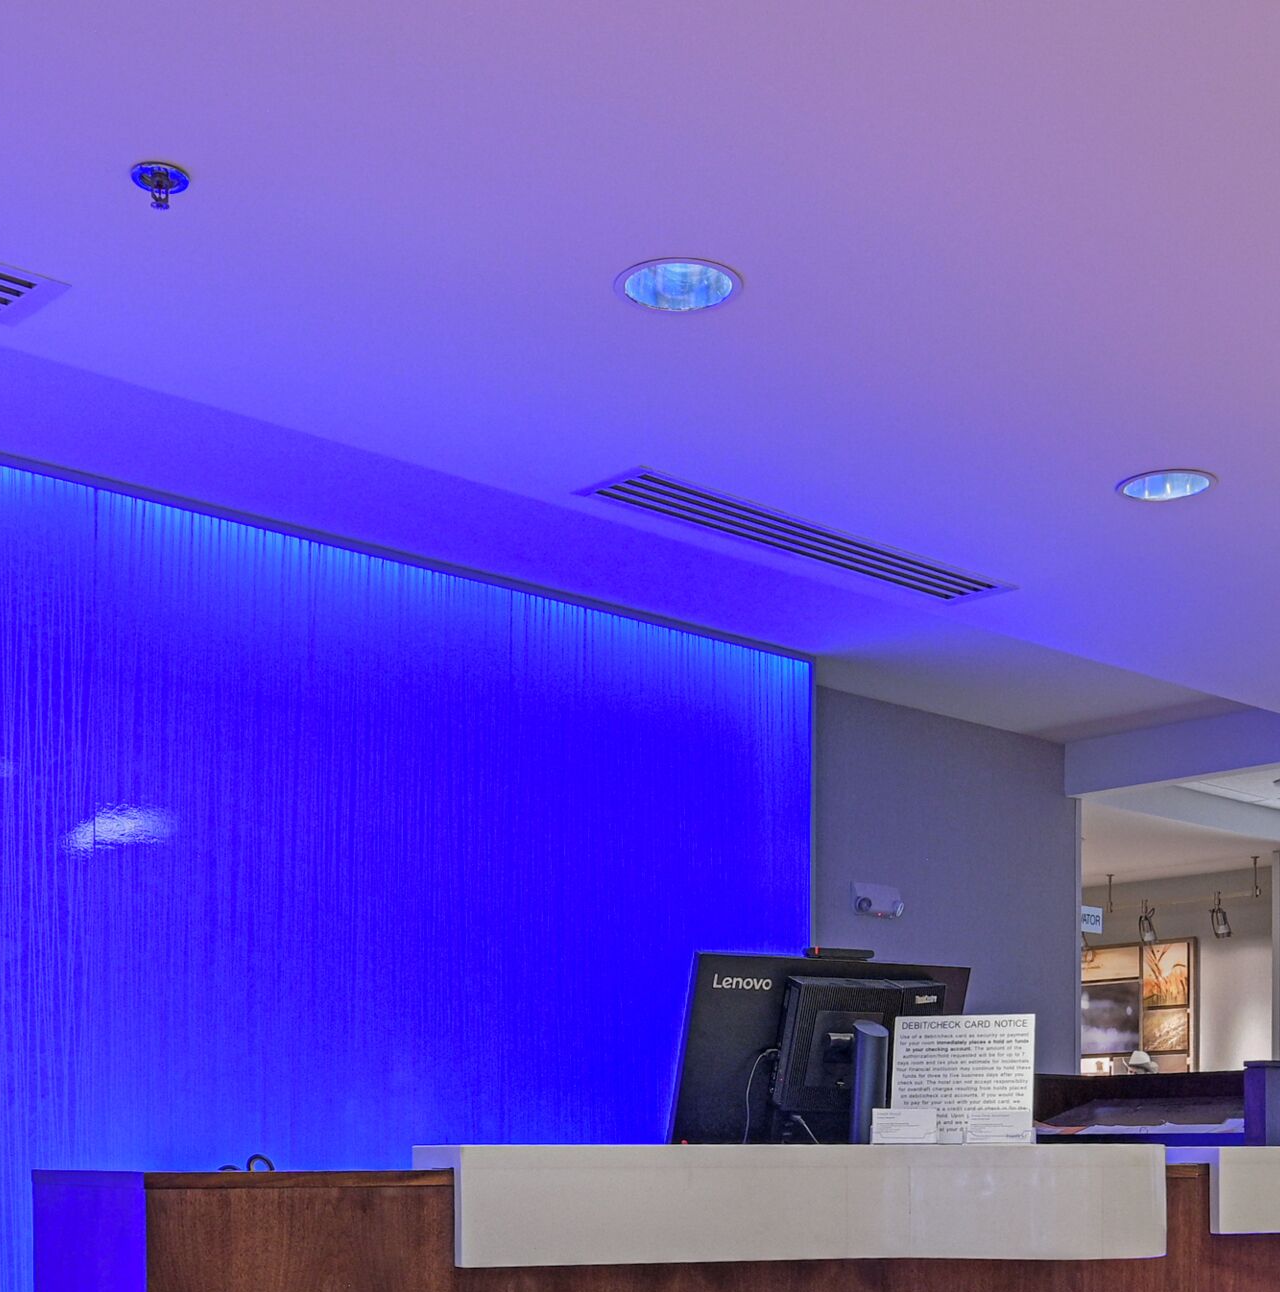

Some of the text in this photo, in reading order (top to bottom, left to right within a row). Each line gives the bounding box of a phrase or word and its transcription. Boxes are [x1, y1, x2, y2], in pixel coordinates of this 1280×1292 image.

[712, 973, 772, 992] Lenovo
[902, 1019, 1028, 1030] DEBIT/CHECK CARD NOTICE
